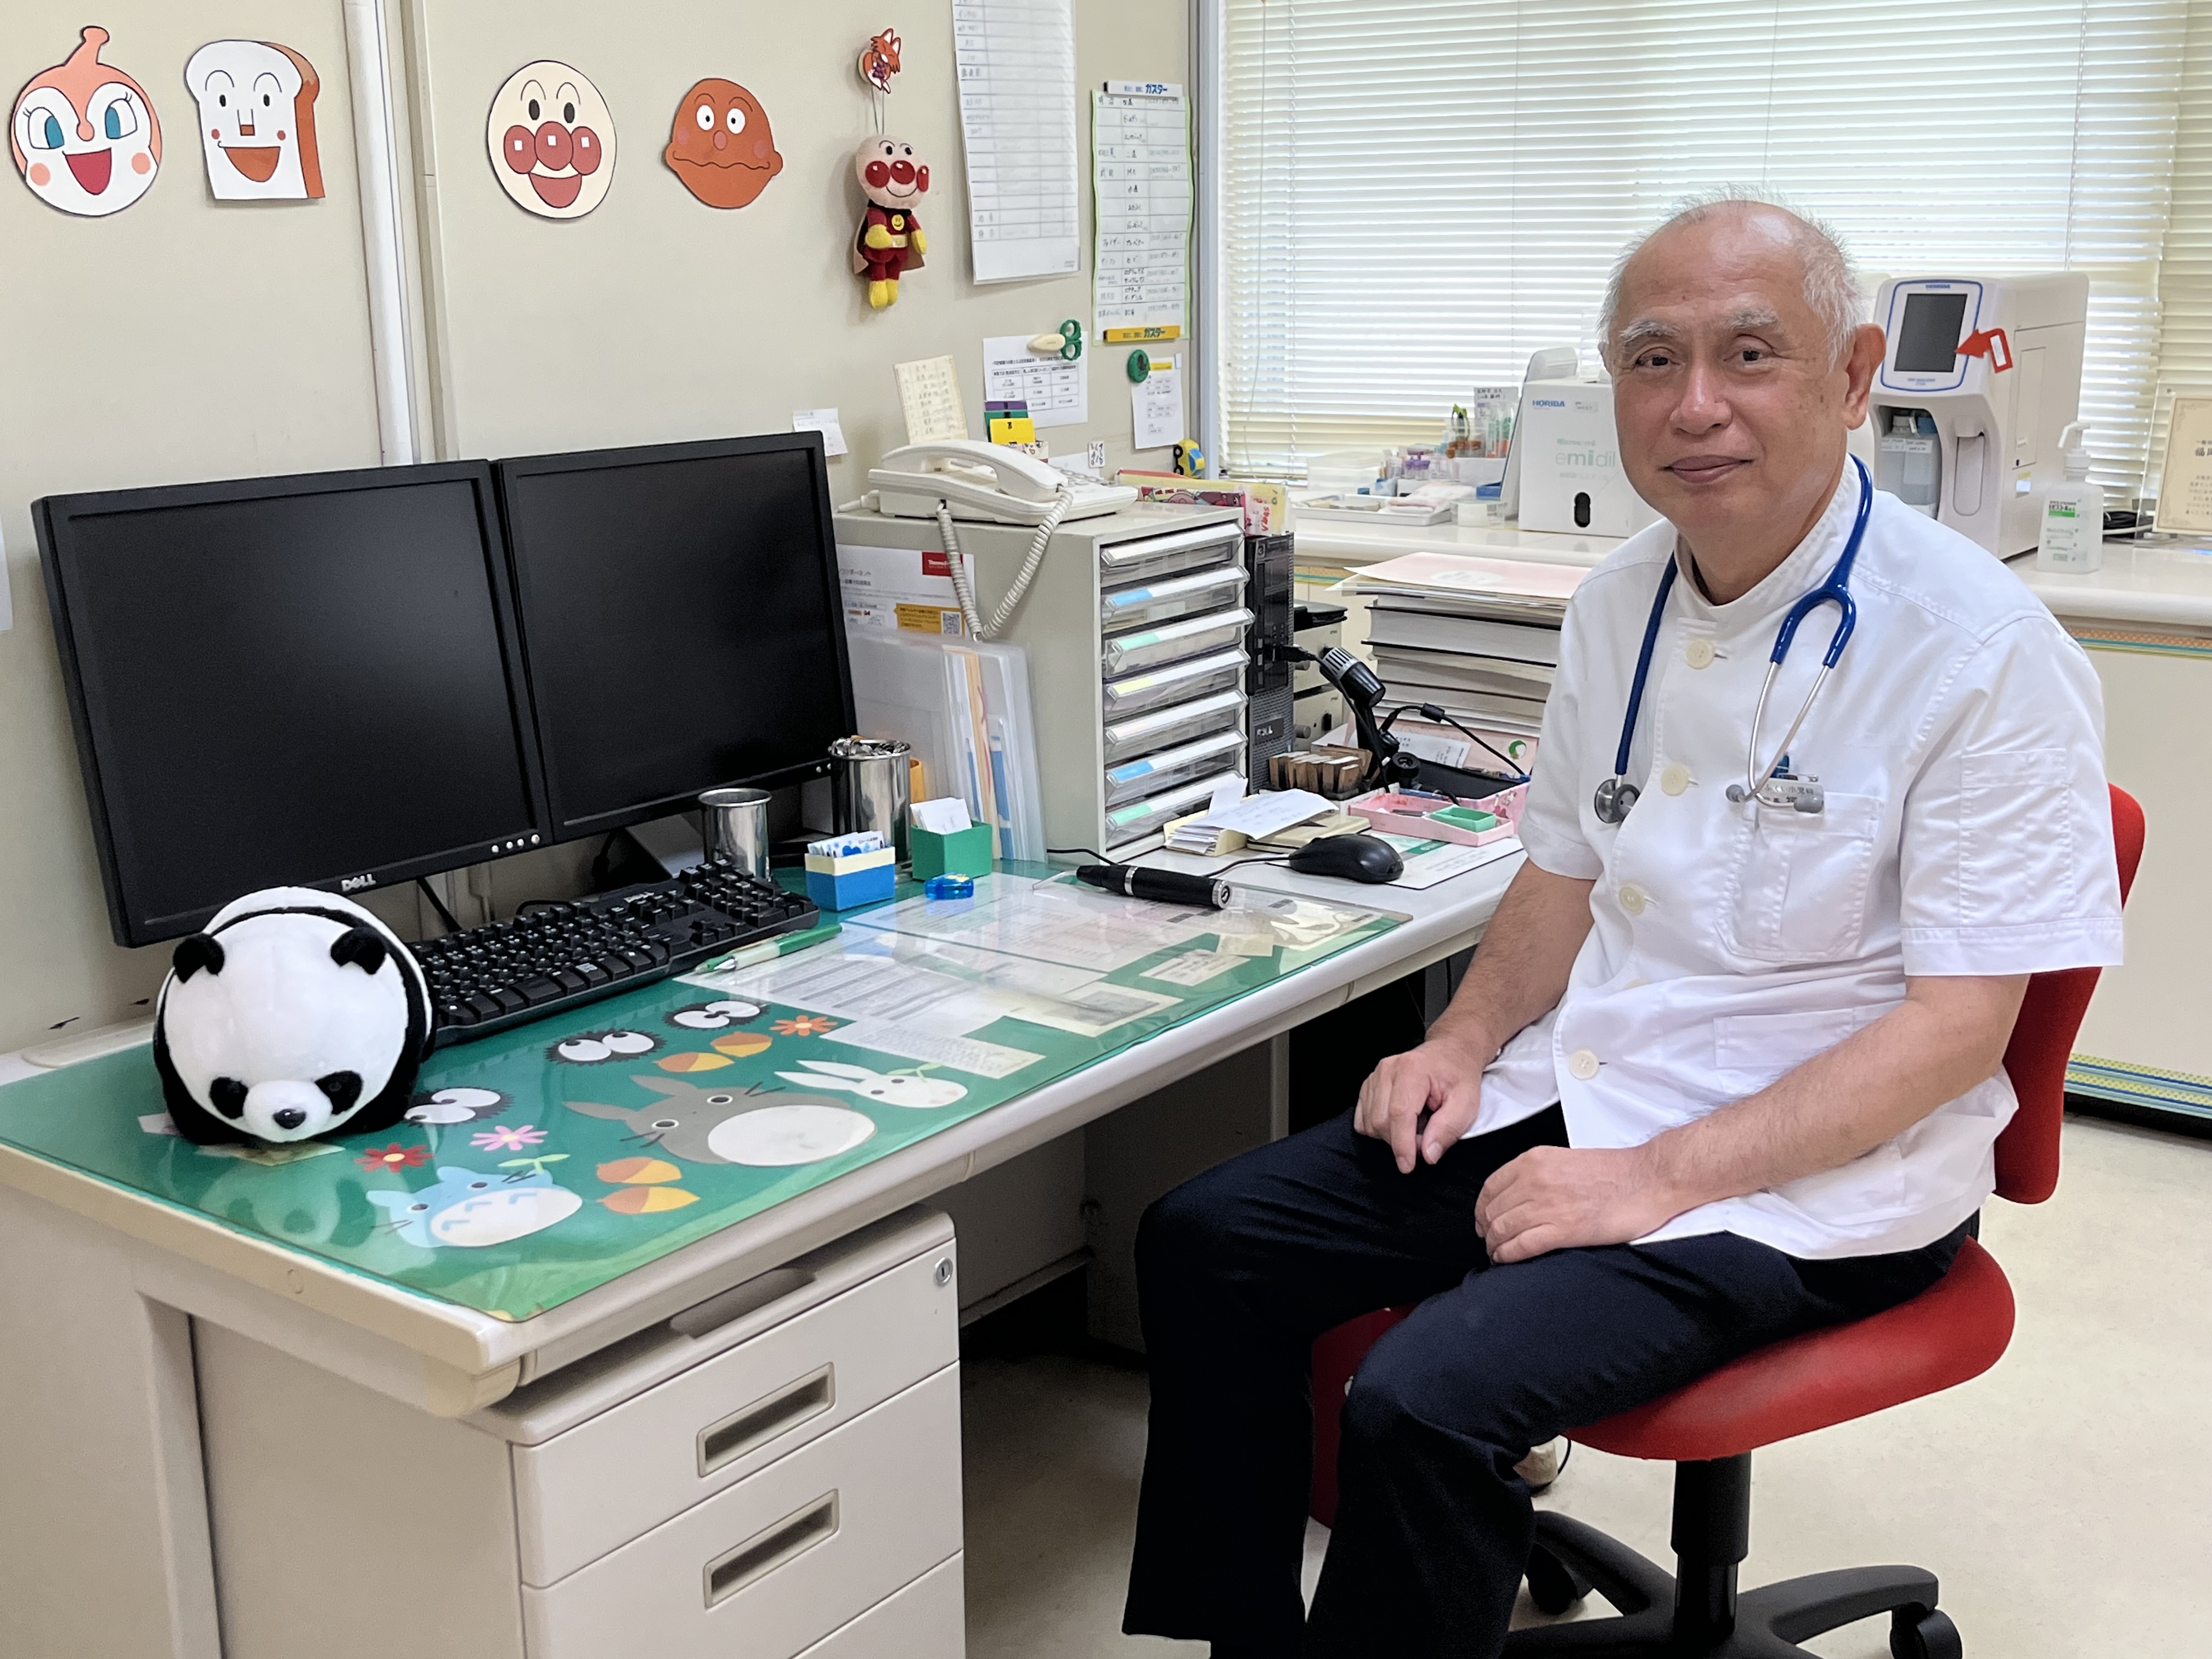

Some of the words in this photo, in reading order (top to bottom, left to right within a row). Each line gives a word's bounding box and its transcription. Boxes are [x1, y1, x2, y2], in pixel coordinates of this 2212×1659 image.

[1146, 83, 1167, 94] ガスター
[1144, 327, 1166, 338] ガスター
[341, 873, 377, 891] DELL
